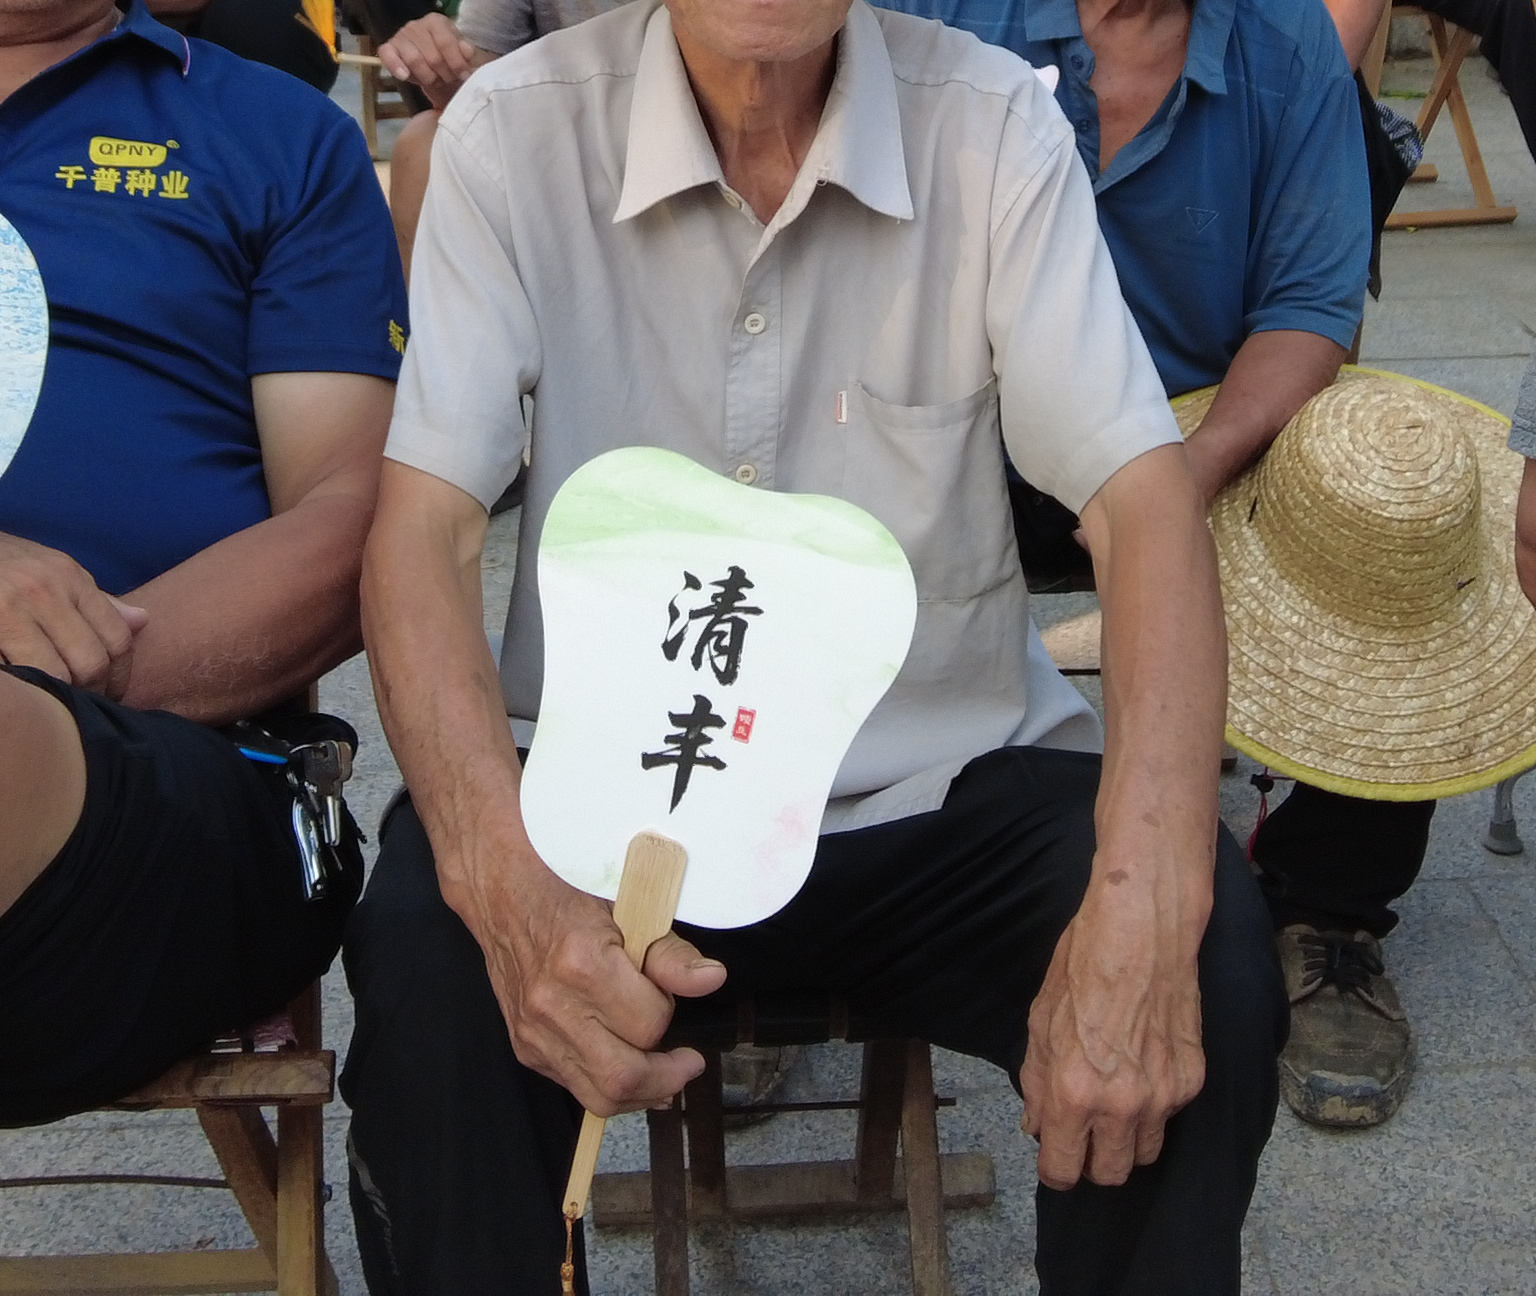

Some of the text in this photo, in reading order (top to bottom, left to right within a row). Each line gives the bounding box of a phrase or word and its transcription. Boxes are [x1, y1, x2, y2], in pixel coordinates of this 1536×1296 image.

[98, 142, 158, 157] QPNY
[55, 165, 190, 199] 千普种业
[641, 565, 764, 815] 清丰
